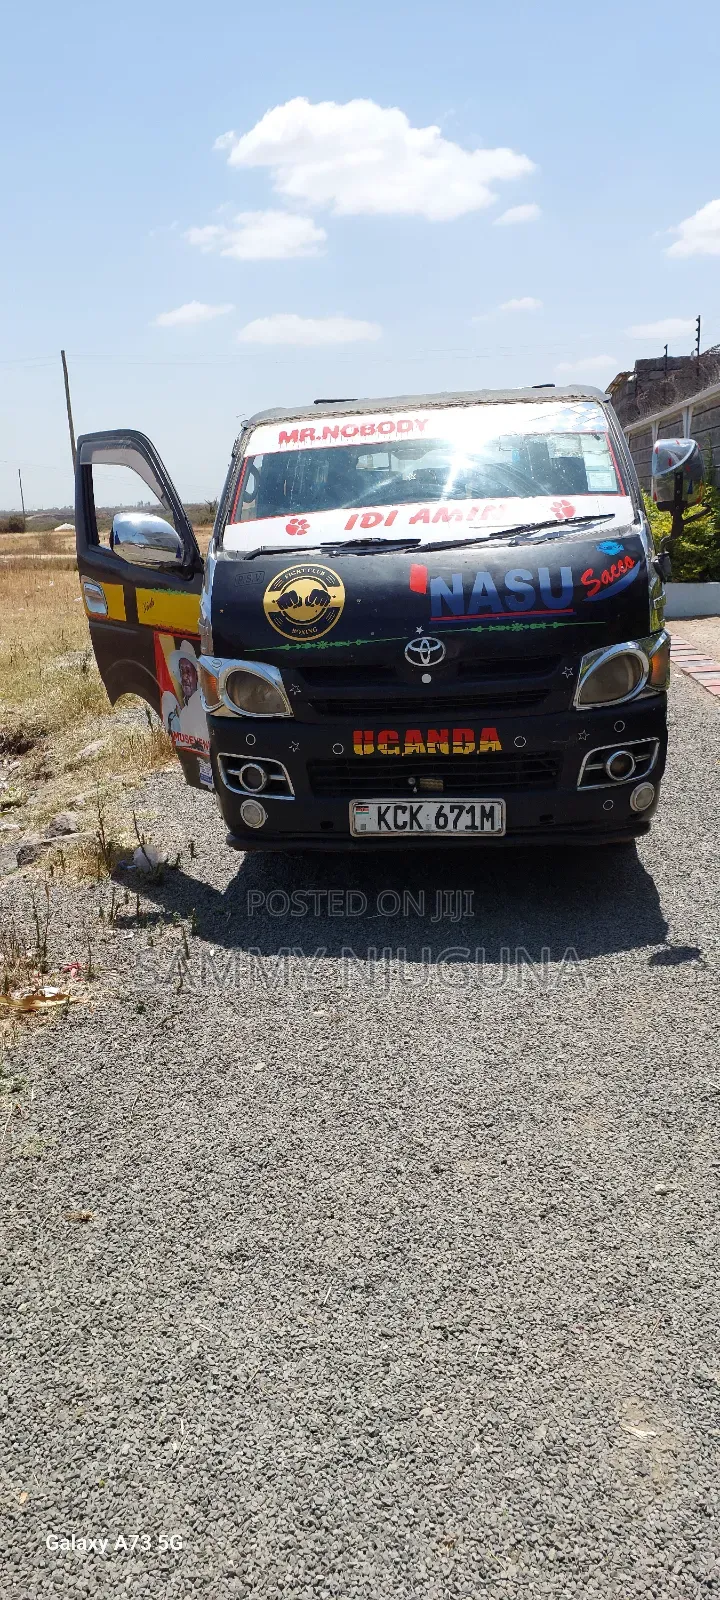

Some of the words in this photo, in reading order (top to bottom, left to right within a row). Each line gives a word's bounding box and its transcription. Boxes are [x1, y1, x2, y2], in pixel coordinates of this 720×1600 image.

[278, 419, 429, 447] MR.NOBODY
[344, 510, 398, 530] IDI
[580, 555, 635, 597] Sacco
[430, 566, 574, 617] NASU
[352, 727, 503, 756] UGANDA
[377, 805, 424, 831] KCK
[434, 804, 495, 831] 671M
